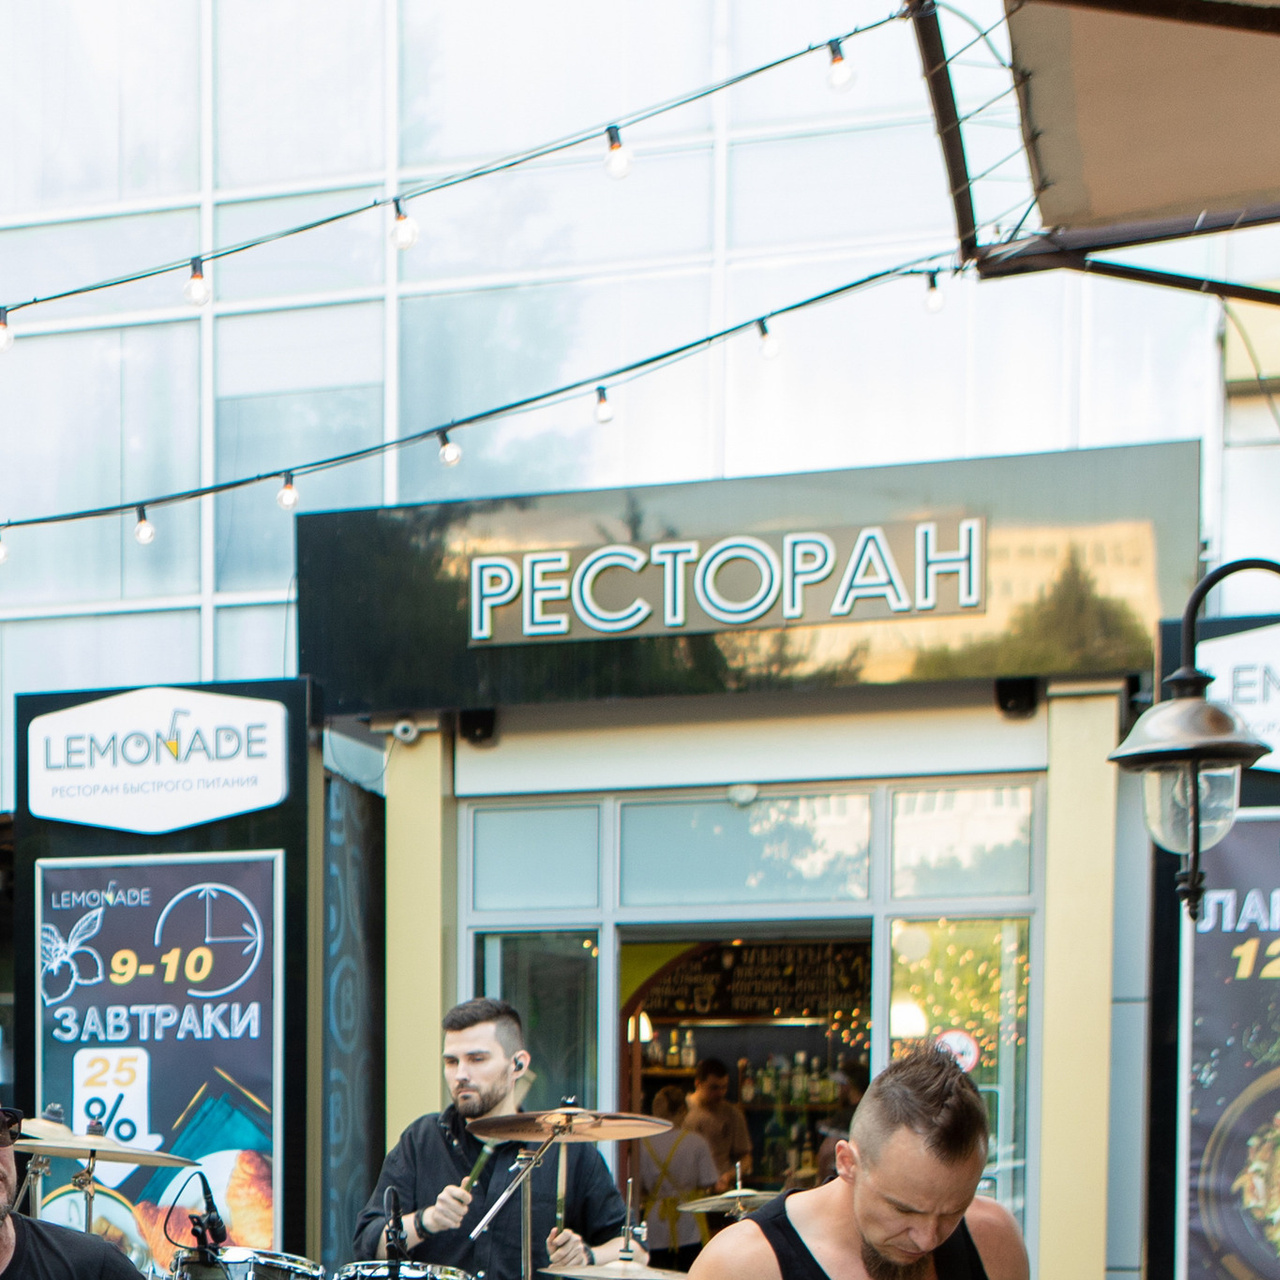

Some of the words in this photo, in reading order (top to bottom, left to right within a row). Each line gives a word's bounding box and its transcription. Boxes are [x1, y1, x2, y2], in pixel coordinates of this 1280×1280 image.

[470, 518, 986, 641] РЕСТОРАН
[43, 722, 268, 771] LEMONADE
[51, 783, 119, 799] РЕСТОРАН
[122, 779, 194, 796] БЫСТРОГО
[196, 775, 259, 791] ПИТАНИЯ
[51, 887, 152, 911] LEMONADE
[109, 946, 214, 986] 9-10
[52, 1001, 262, 1043] ЗАВТРАКИ
[83, 1056, 138, 1088] 25
